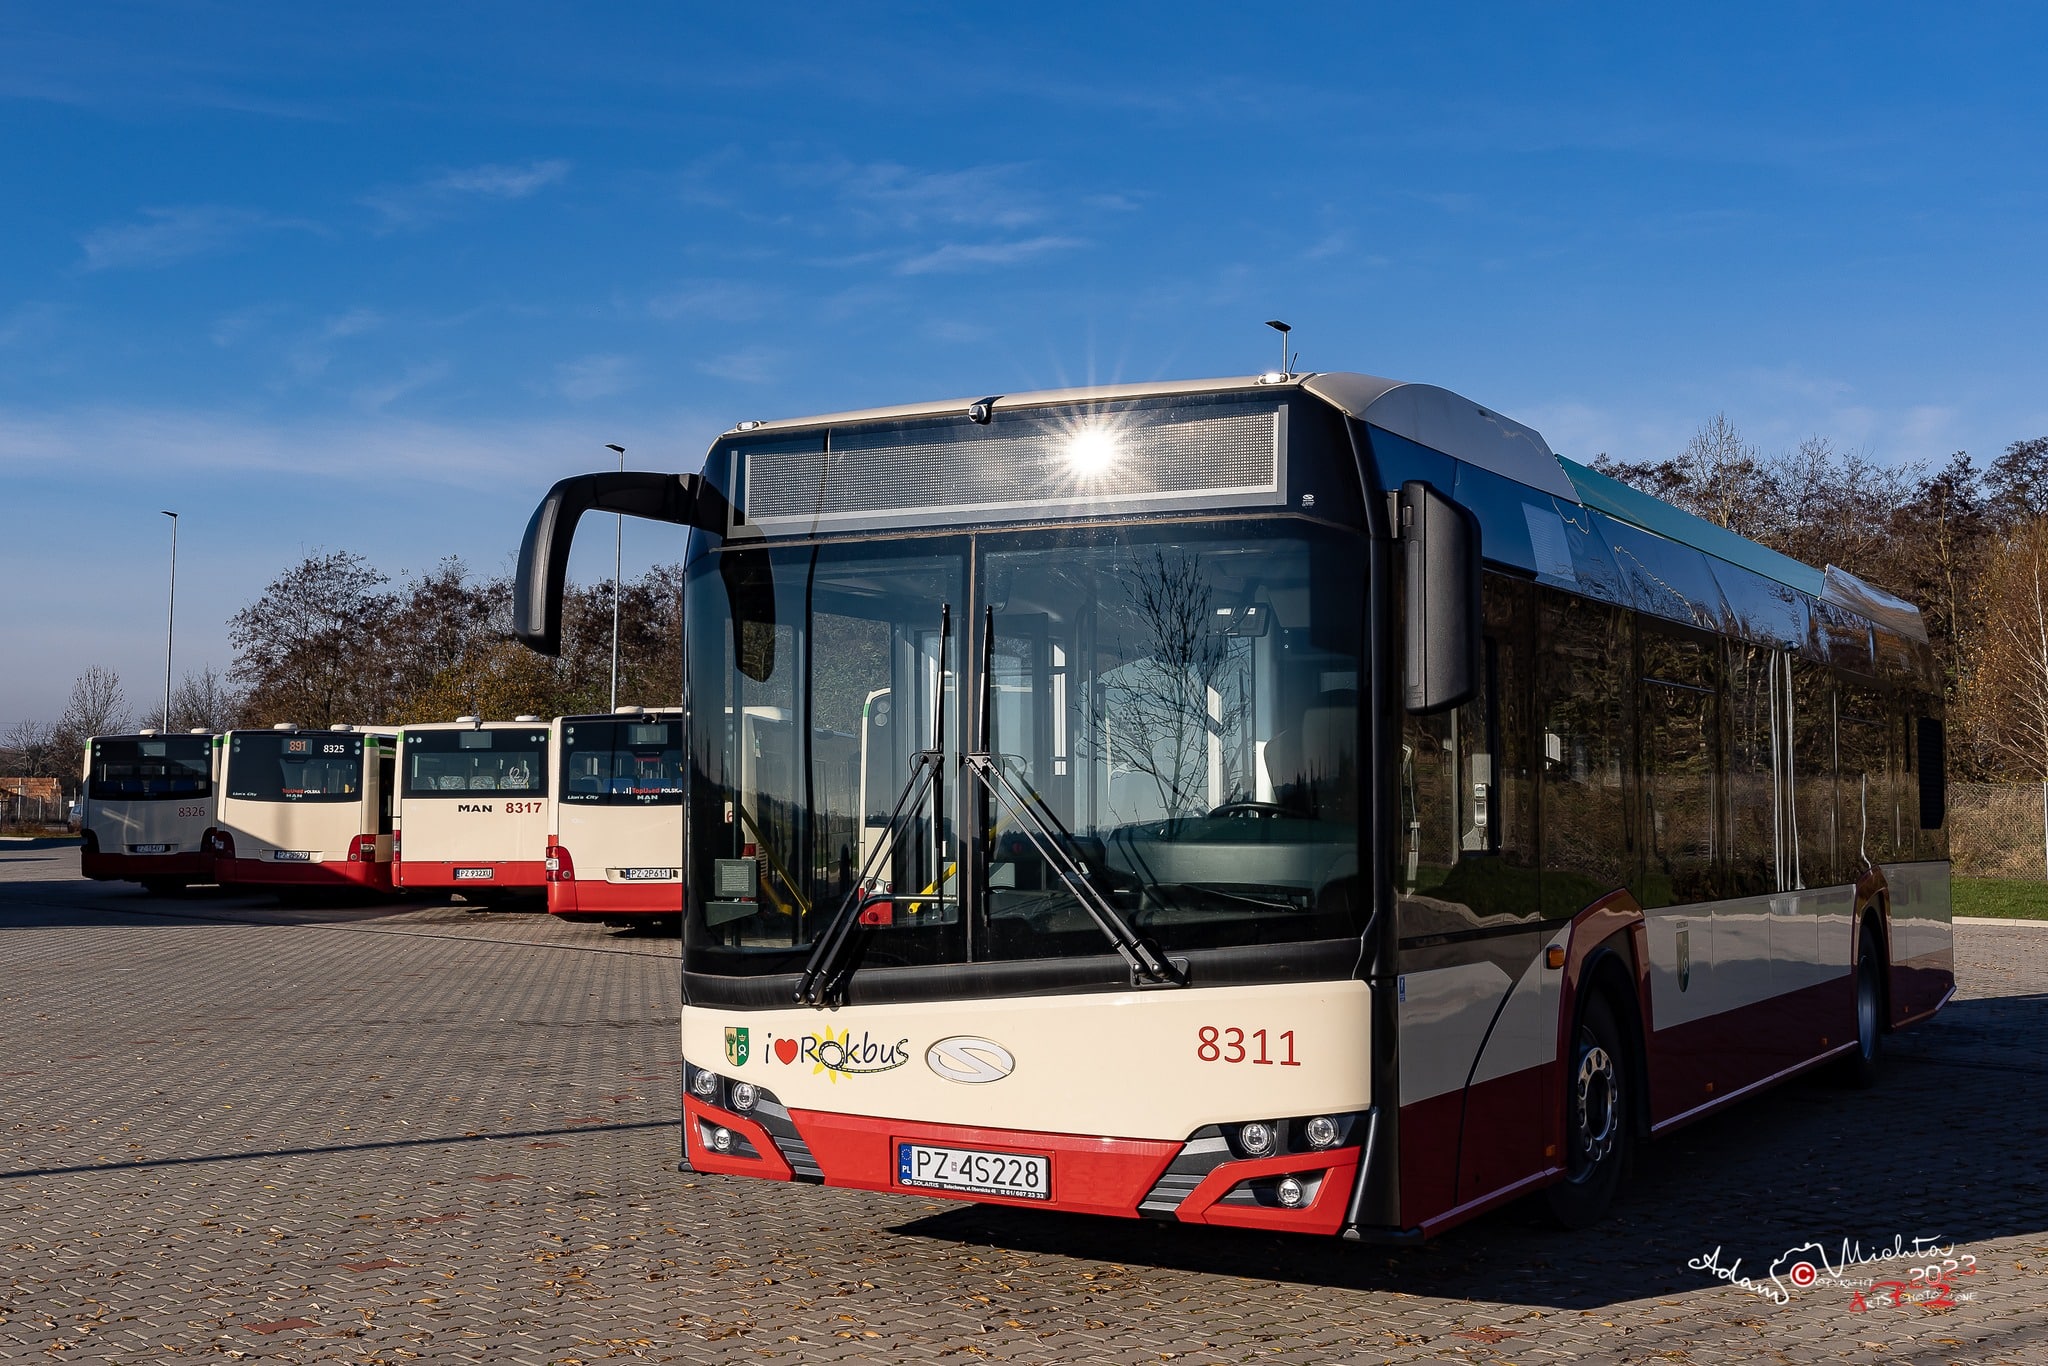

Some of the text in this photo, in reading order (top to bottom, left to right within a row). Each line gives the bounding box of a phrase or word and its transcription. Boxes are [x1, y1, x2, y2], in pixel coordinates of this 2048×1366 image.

[289, 740, 307, 752] 891
[323, 744, 345, 754] 8325
[178, 806, 206, 818] 8326
[458, 804, 493, 813] MAN
[505, 802, 542, 814] 8317
[1197, 1025, 1301, 1067] 8311
[800, 1031, 910, 1074] Rokbus
[902, 1165, 911, 1174] PL
[917, 1150, 1039, 1188] PZ 4S228
[912, 1180, 940, 1188] SOLARIS
